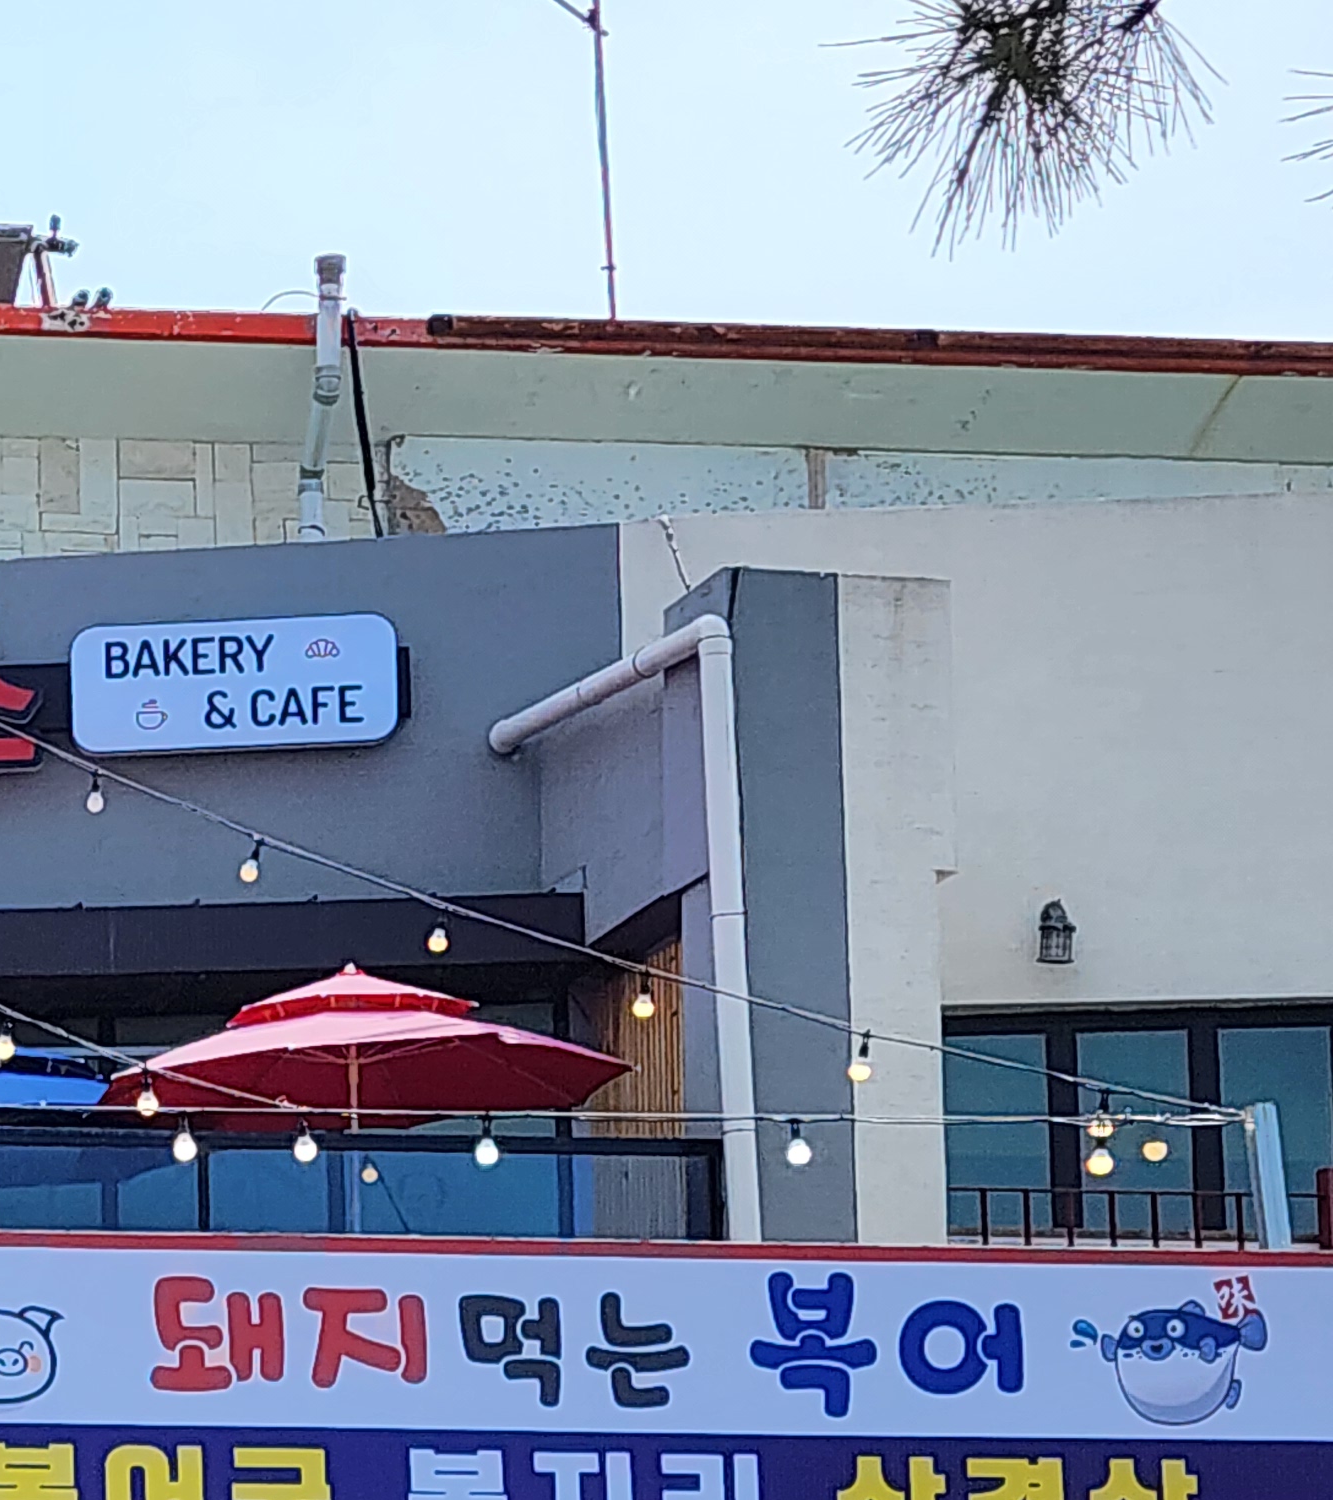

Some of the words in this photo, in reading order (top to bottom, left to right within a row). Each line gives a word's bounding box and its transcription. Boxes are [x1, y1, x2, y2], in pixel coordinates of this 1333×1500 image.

[104, 634, 274, 679] BAKERY
[204, 690, 237, 729] &
[250, 685, 364, 727] CAFE
[151, 1276, 427, 1391] 돼지
[459, 1291, 690, 1408] 먹는
[749, 1271, 1024, 1418] 복어
